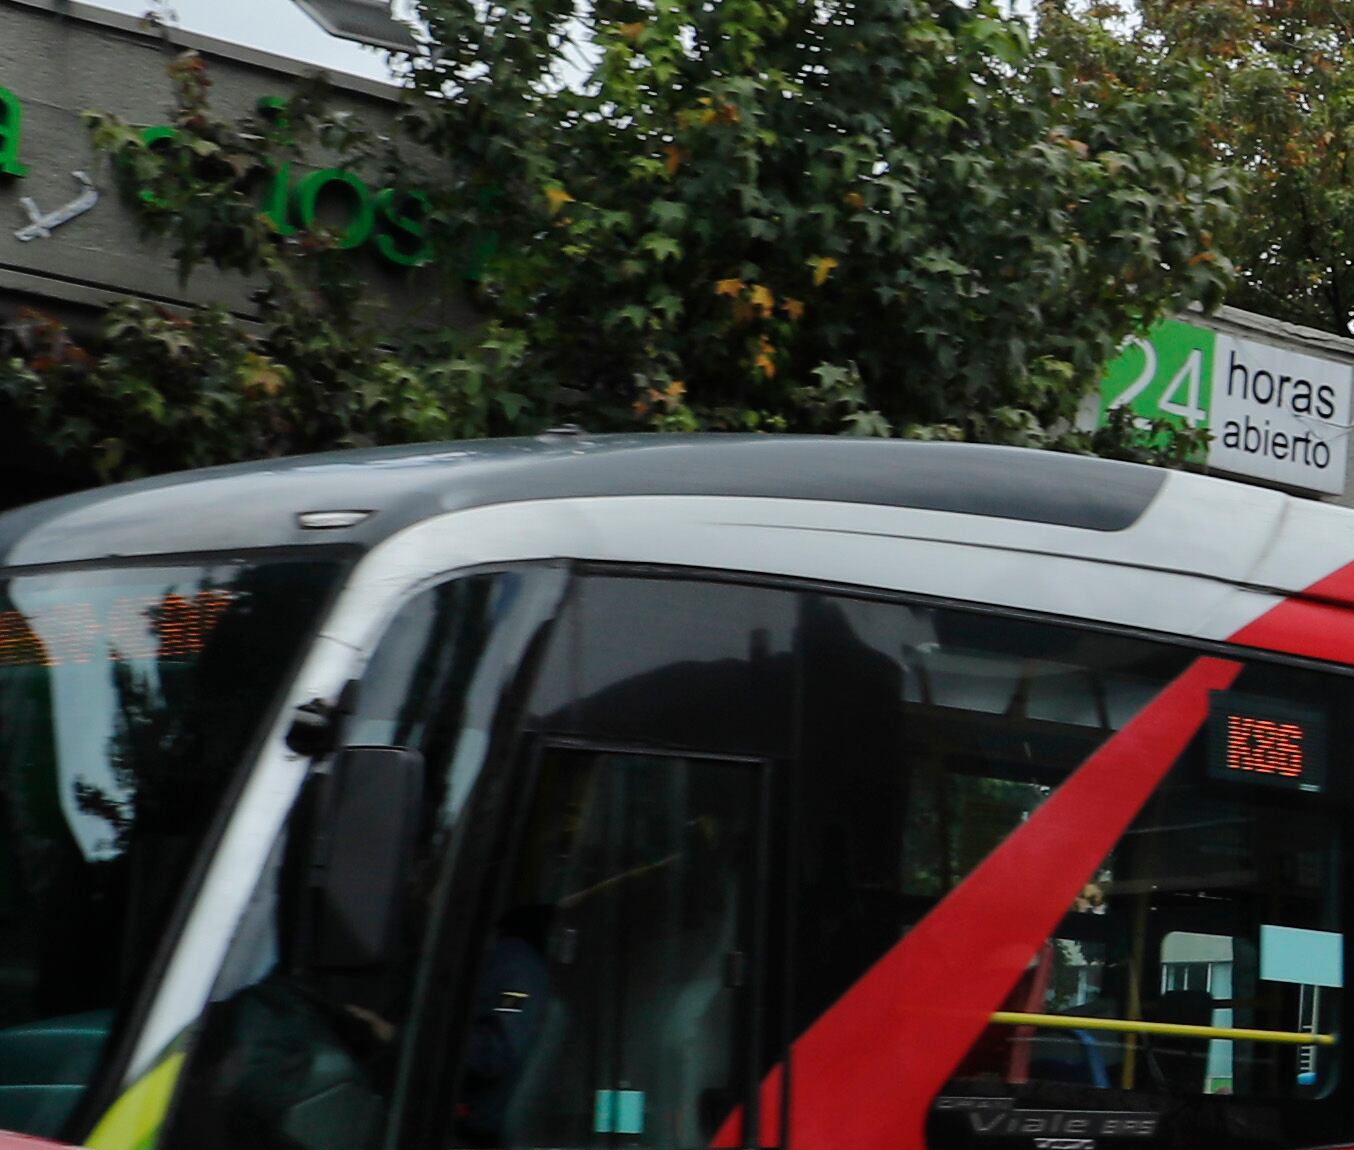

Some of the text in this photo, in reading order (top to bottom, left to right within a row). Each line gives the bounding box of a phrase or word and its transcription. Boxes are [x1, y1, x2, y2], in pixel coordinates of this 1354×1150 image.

[1106, 333, 1336, 431] 24 horas
[1223, 415, 1331, 470] abierto
